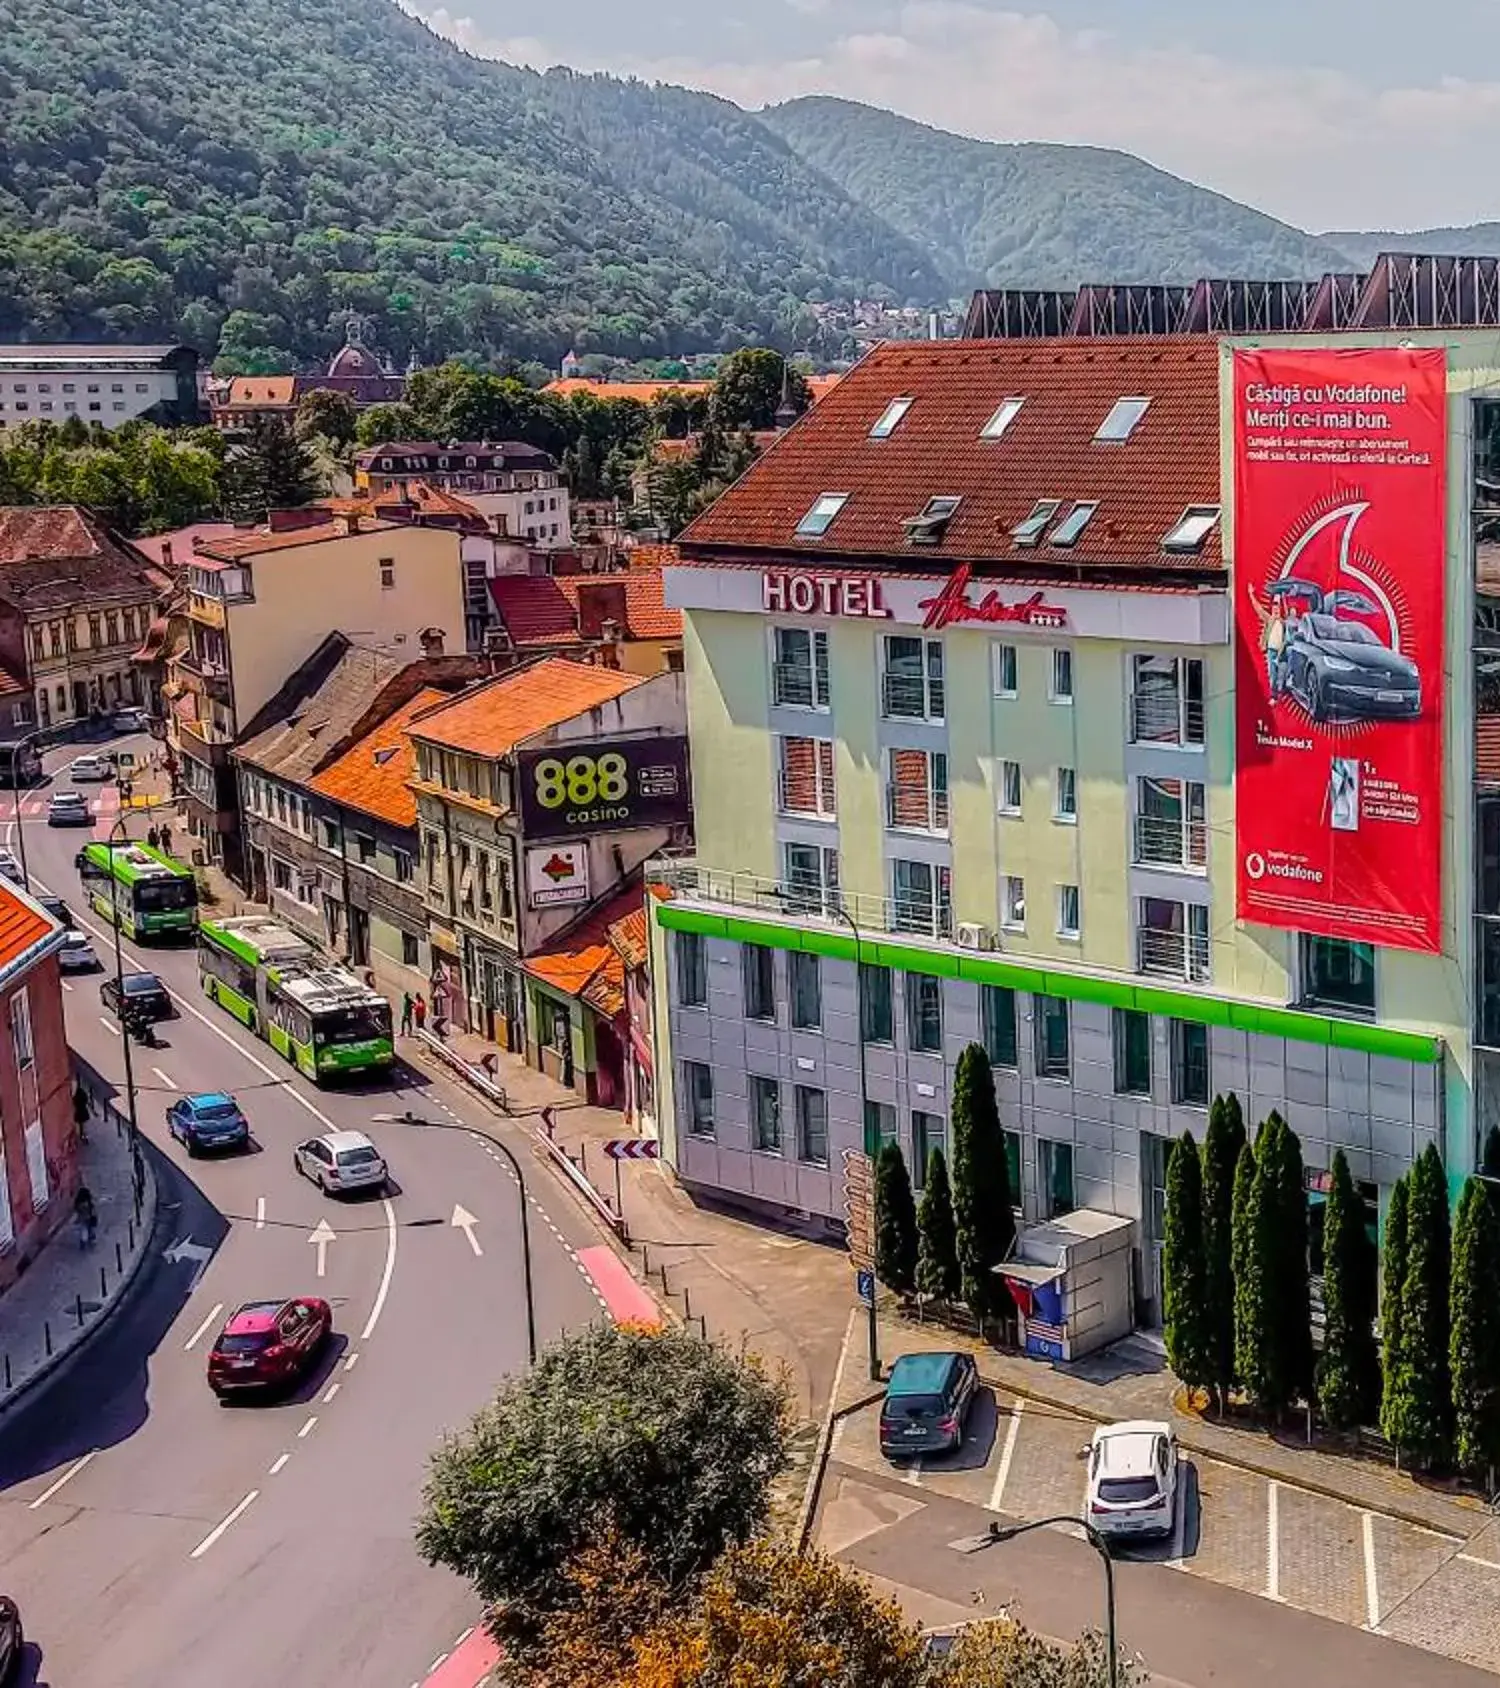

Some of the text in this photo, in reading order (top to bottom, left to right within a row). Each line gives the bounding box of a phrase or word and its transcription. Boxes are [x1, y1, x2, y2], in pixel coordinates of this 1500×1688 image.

[1303, 387, 1322, 402] cu
[1326, 384, 1406, 403] Vodafone!
[1293, 411, 1320, 428] ce-i
[1323, 411, 1352, 428] mai
[1356, 410, 1391, 428] bun.
[763, 573, 888, 617] HOTEL
[535, 752, 629, 809] 888
[565, 806, 630, 824] casino
[1267, 863, 1323, 883] vodafone
